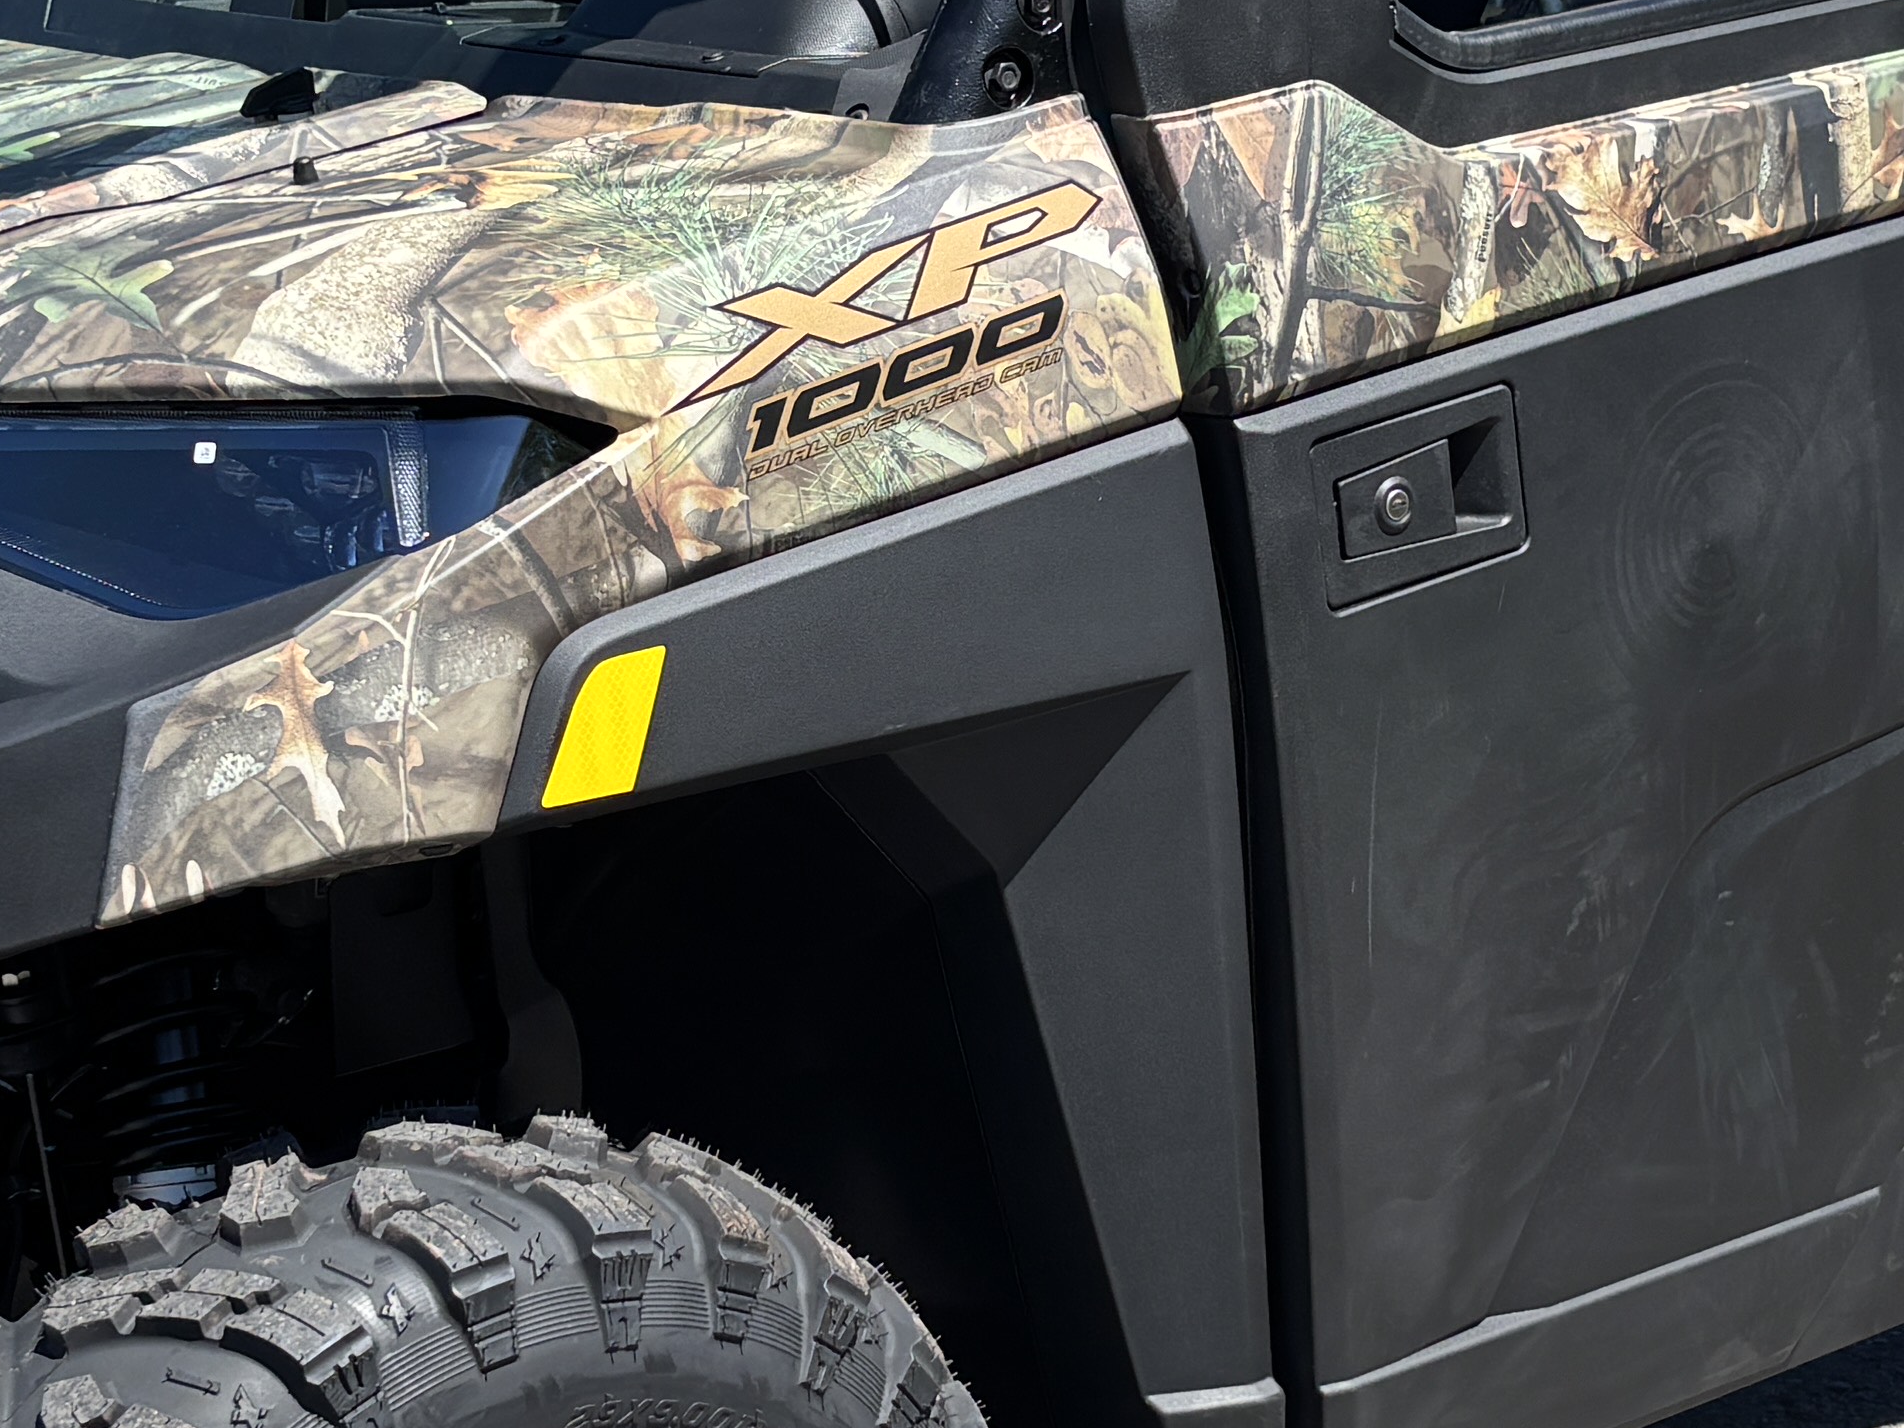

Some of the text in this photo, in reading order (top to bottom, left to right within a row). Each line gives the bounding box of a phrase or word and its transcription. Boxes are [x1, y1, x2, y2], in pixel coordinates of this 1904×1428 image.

[663, 178, 1102, 414] XP
[744, 288, 1070, 460] 1000
[747, 347, 1063, 481] DUAL OVERHEAD CAM
